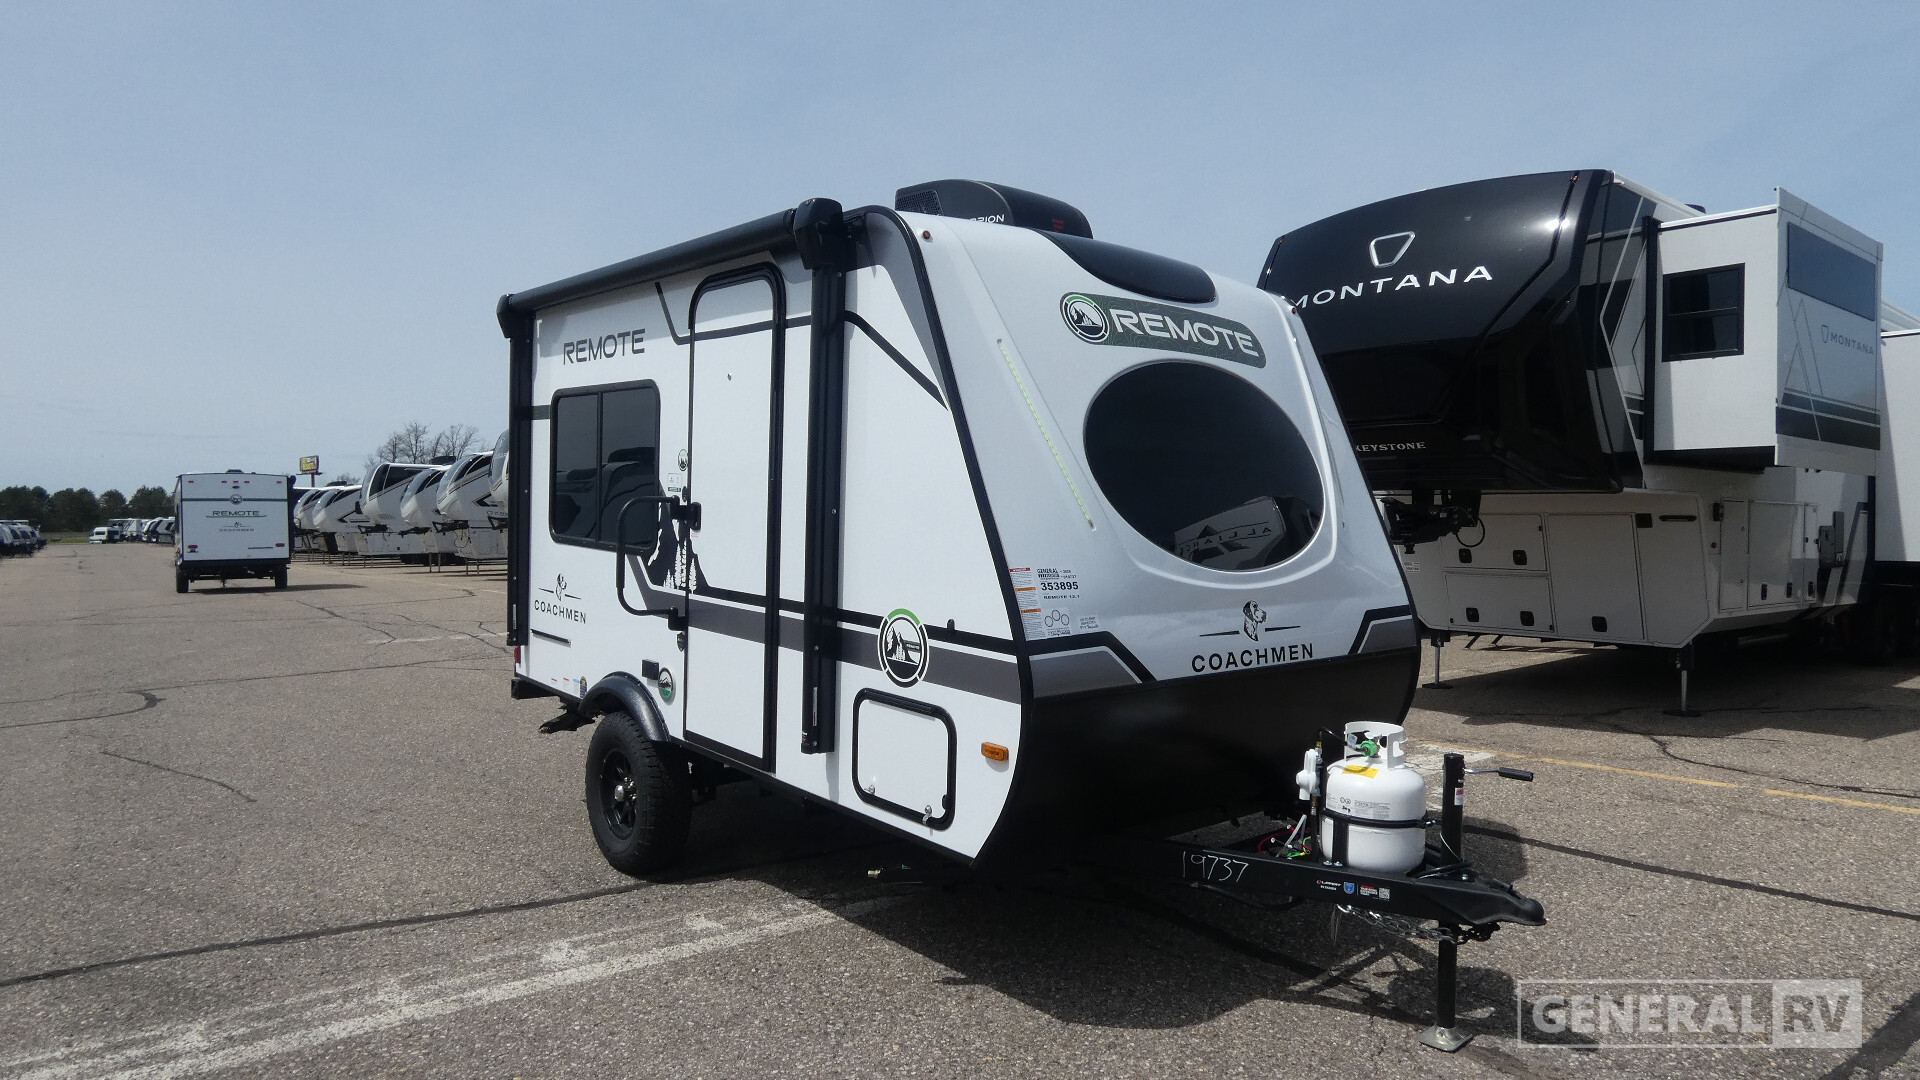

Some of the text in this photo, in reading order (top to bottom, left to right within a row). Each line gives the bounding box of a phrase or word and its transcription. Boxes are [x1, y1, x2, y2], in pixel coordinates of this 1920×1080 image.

[1290, 265, 1493, 309] MONTANA
[563, 328, 646, 365] REMOTE
[1109, 308, 1260, 357] REMOTE
[1830, 331, 1875, 355] MONTANA
[1040, 581, 1079, 591] 353895
[534, 599, 587, 624] COACHMEN
[1191, 643, 1313, 673] COACHMEN
[1183, 851, 1249, 882] 19737
